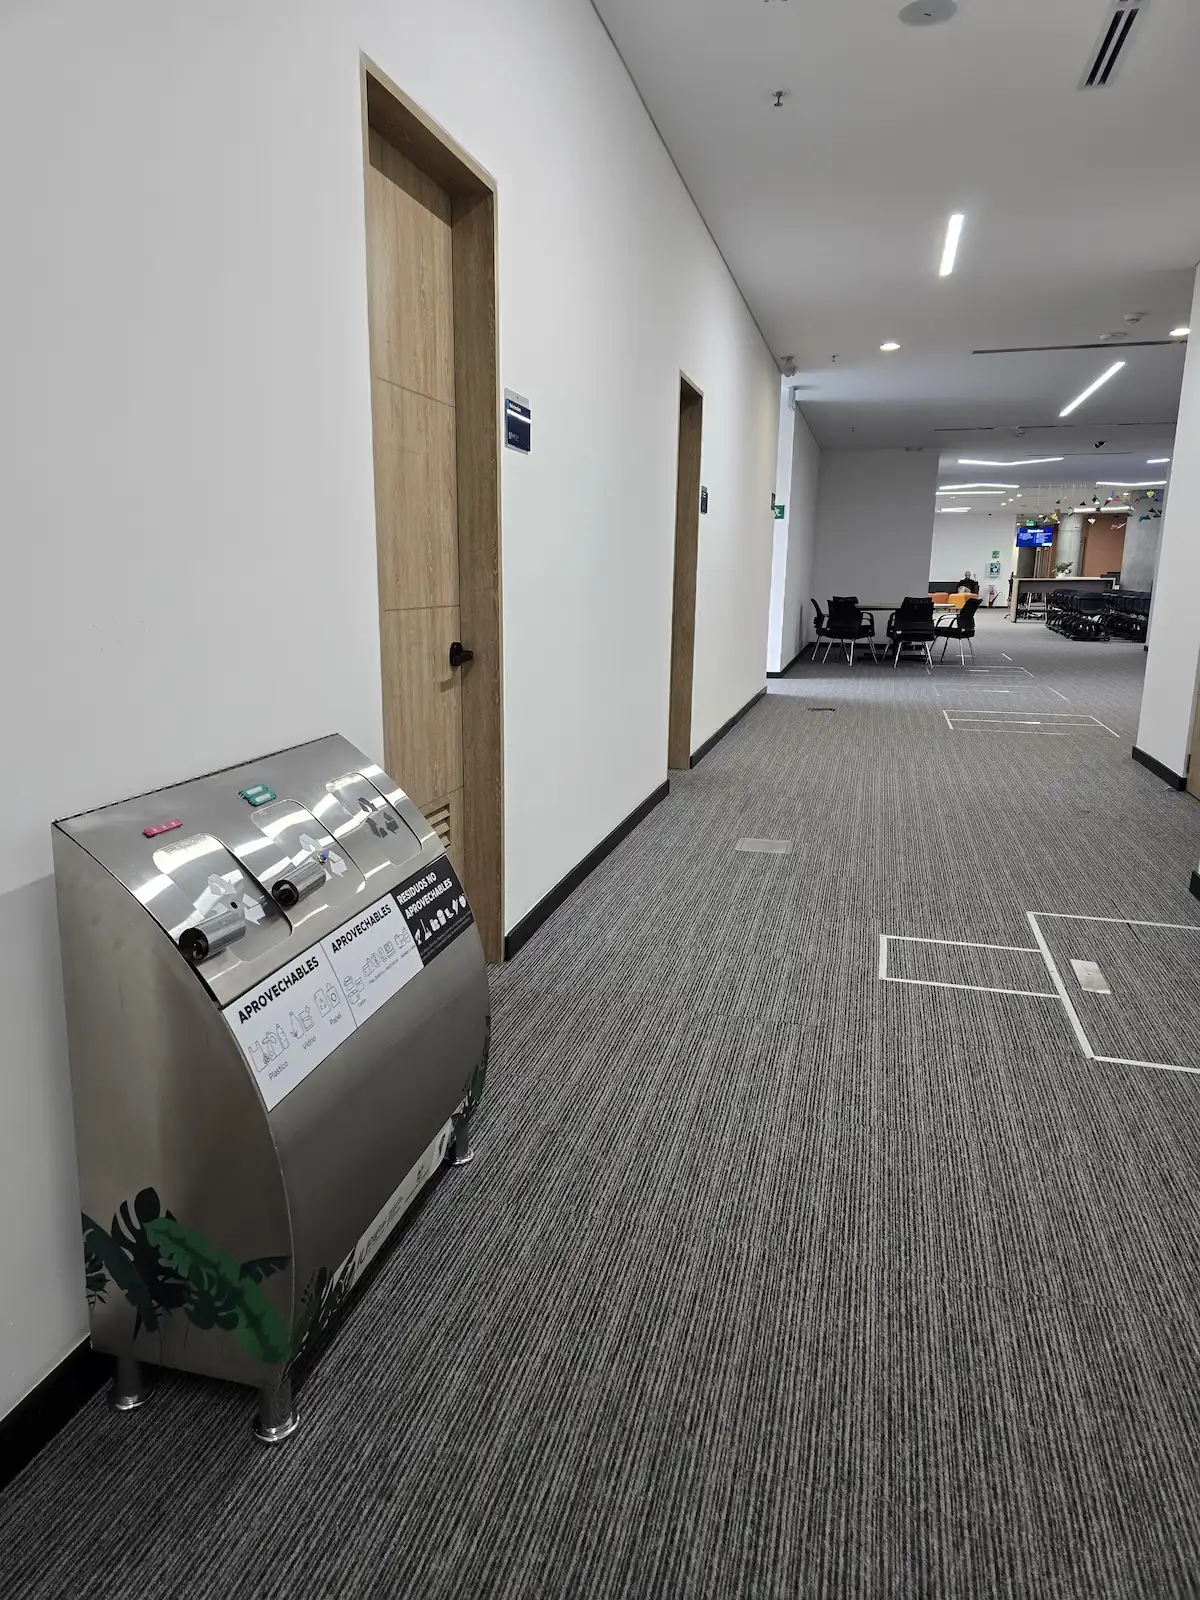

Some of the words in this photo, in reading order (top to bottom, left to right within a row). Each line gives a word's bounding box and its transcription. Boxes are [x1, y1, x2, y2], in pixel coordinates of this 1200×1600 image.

[396, 877, 428, 905] RESIDUOS
[425, 871, 437, 885] NO
[404, 877, 453, 920] APROVECHABLES
[331, 903, 392, 954] APROVECHABLES
[237, 956, 320, 1025] APROVECHABLES
